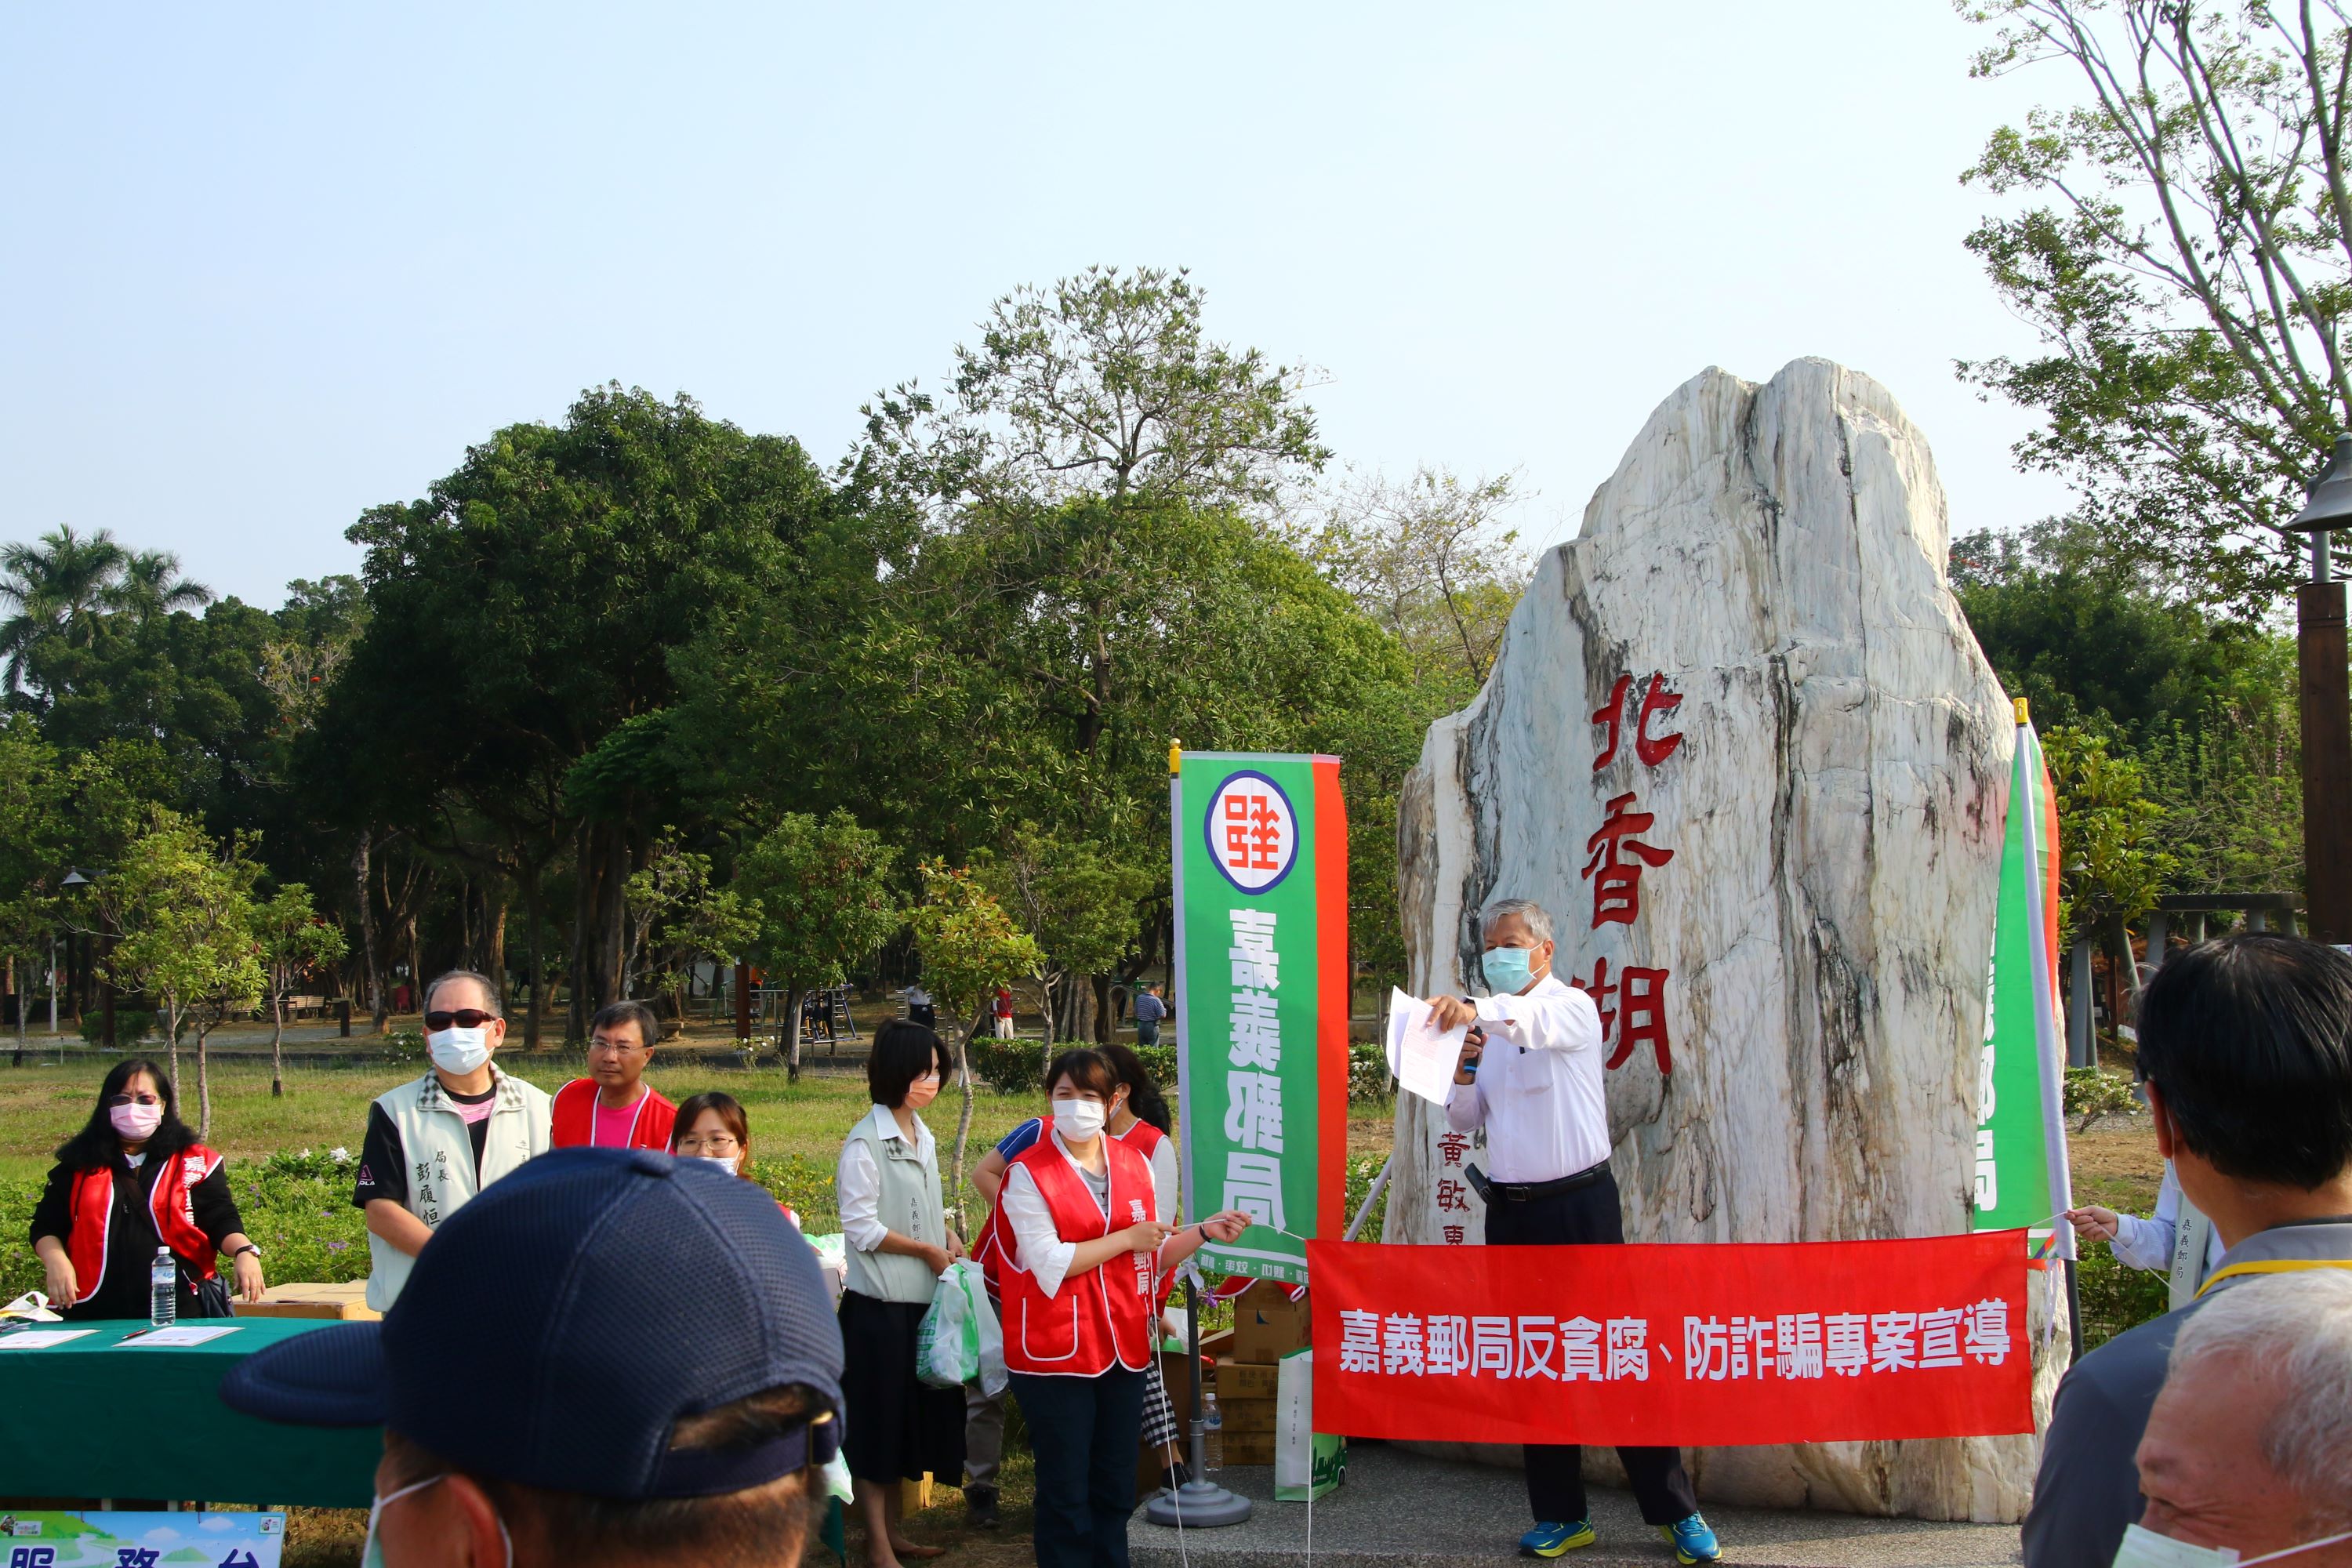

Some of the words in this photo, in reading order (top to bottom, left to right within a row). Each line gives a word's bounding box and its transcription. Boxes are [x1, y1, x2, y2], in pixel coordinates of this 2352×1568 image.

[1571, 672, 1683, 1075] 北香湖
[435, 1150, 450, 1182] 局長
[2176, 1218, 2193, 1279] 嘉義郵局
[1339, 1297, 2011, 1382] 嘉義郵局反貪腐、防詐騙專案宣導
